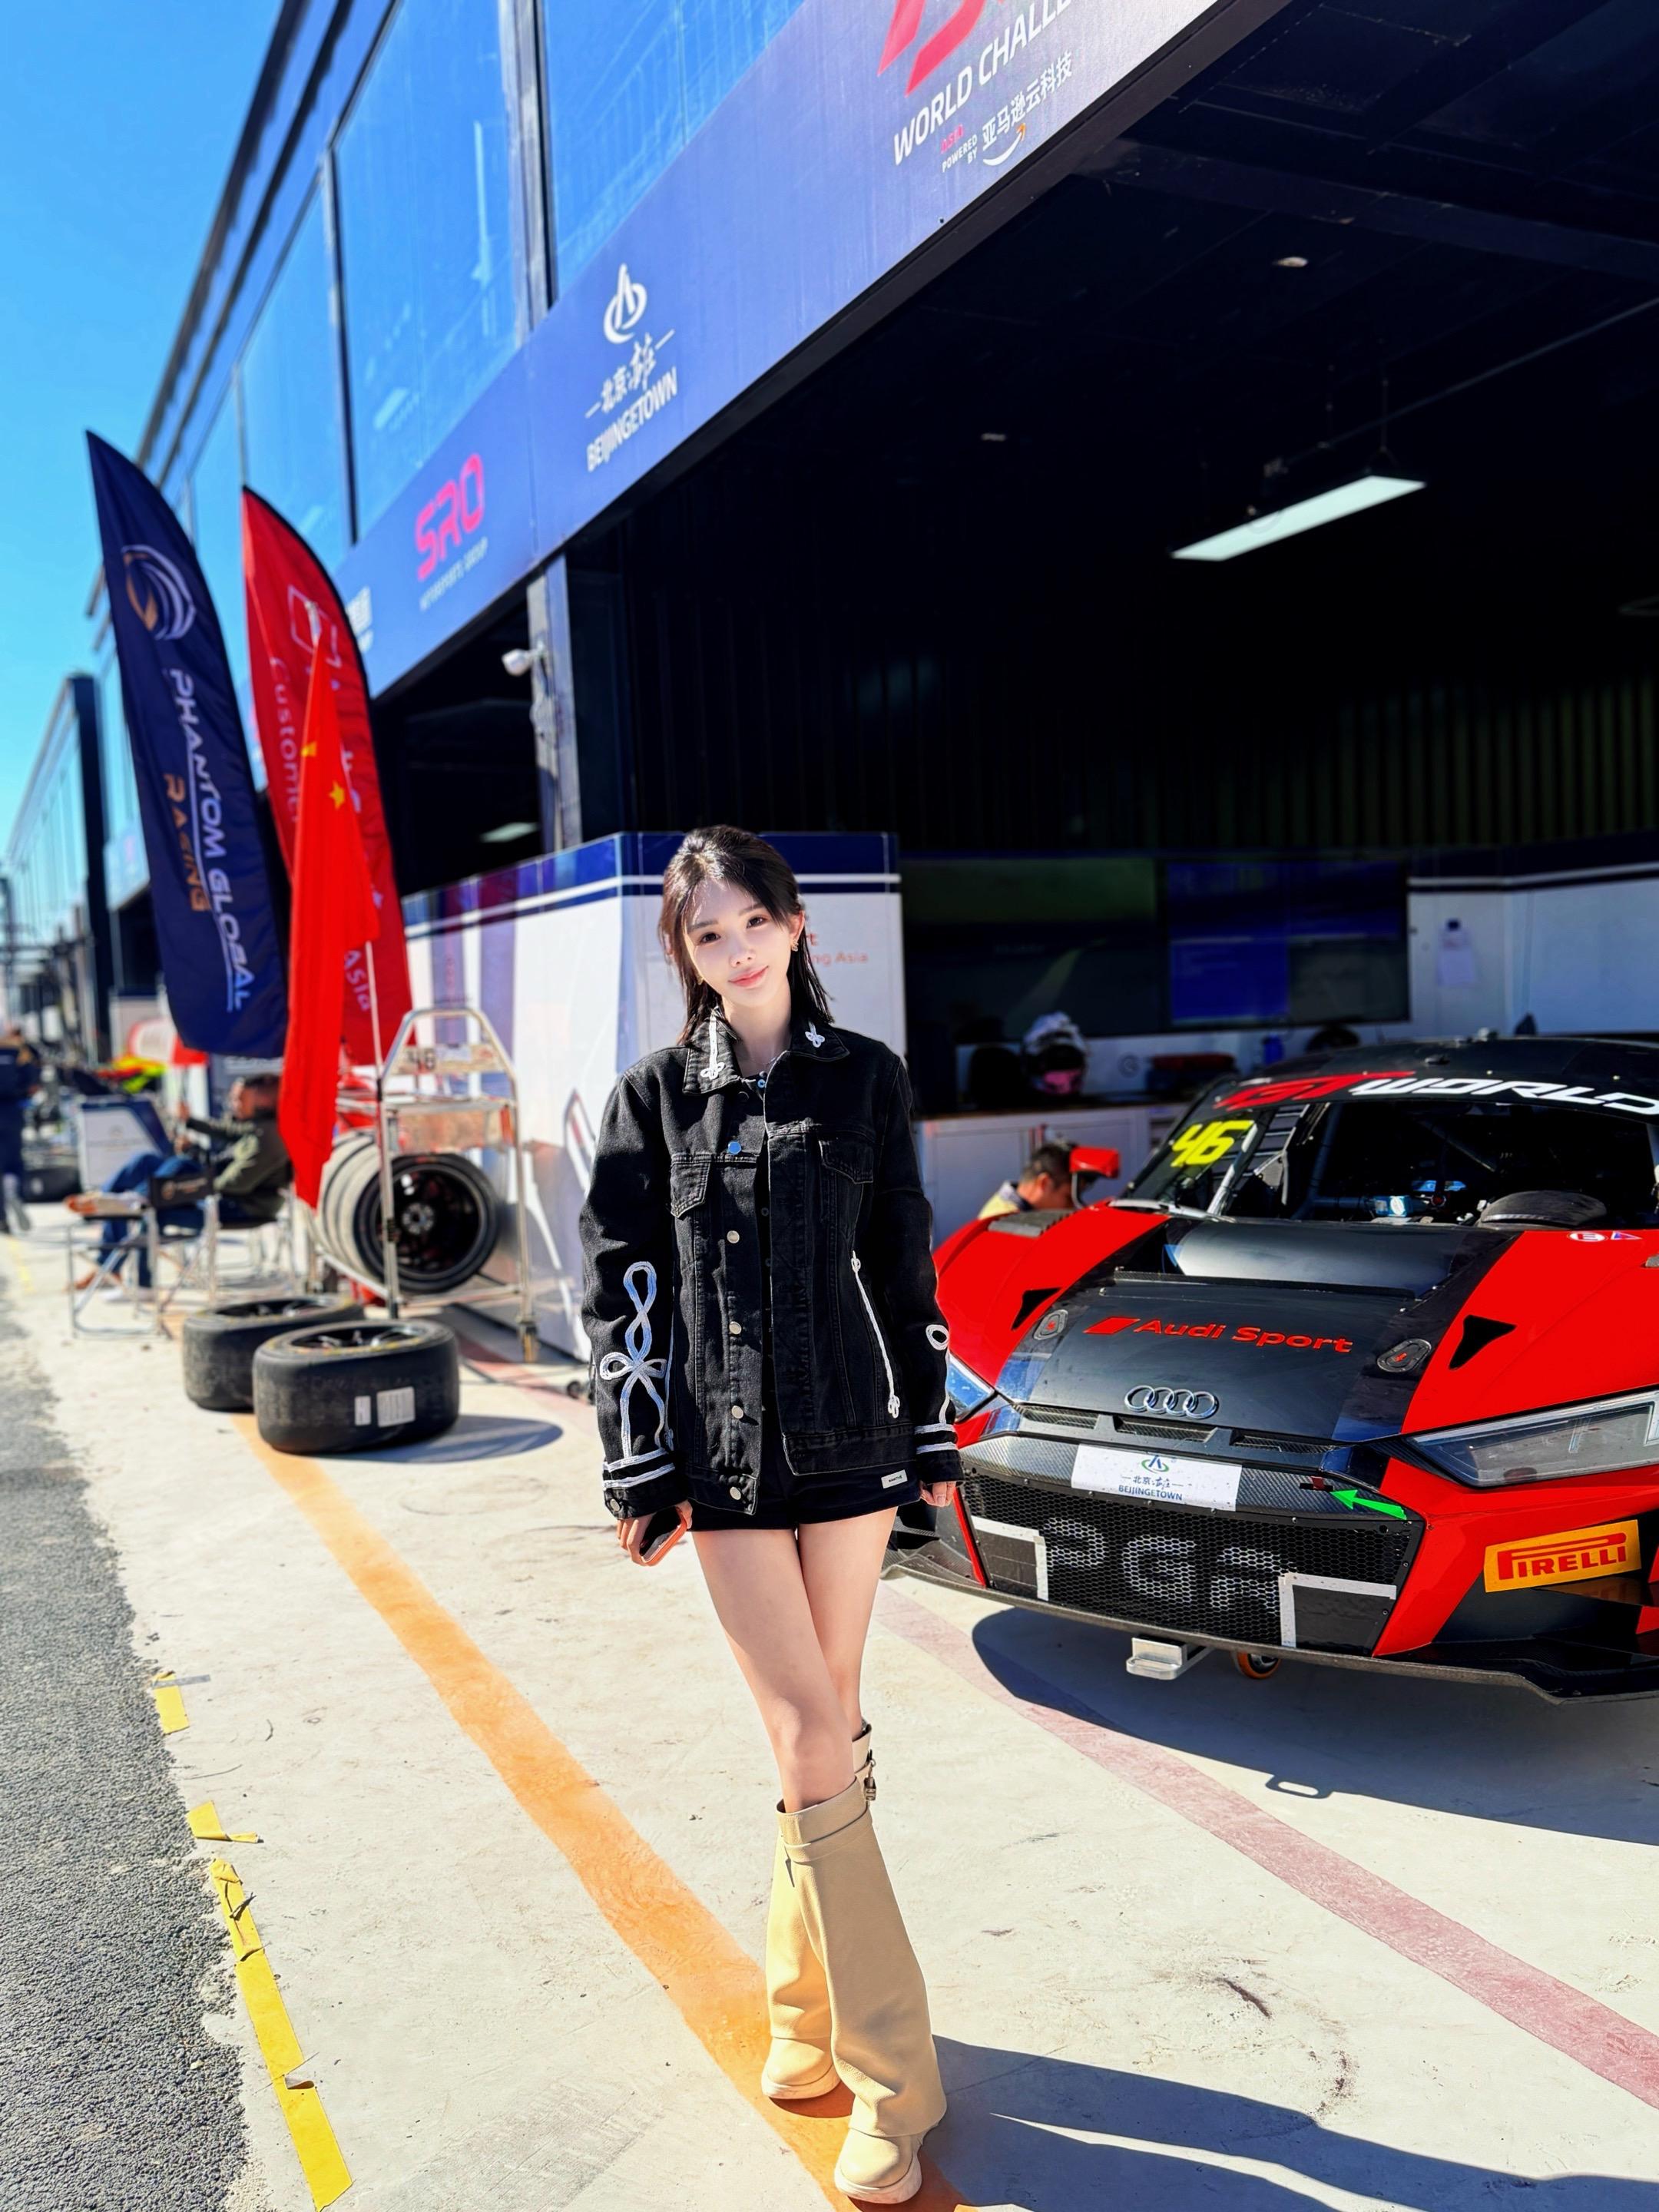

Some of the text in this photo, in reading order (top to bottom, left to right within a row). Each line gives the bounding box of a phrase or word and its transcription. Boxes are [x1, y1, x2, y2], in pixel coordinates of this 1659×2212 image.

[894, 65, 972, 165] WORLD
[982, 50, 1072, 151] 亚马逊云科技
[942, 134, 978, 173] POWERED
[967, 147, 978, 164] BY
[415, 452, 485, 581] SRO
[164, 773, 212, 912] RACING
[171, 668, 255, 1012] PHANTOM GLOBAL
[1171, 1120, 1255, 1167] 46
[1134, 1320, 1353, 1353] Audi Sport
[1498, 1532, 1627, 1581] PIRELLI
